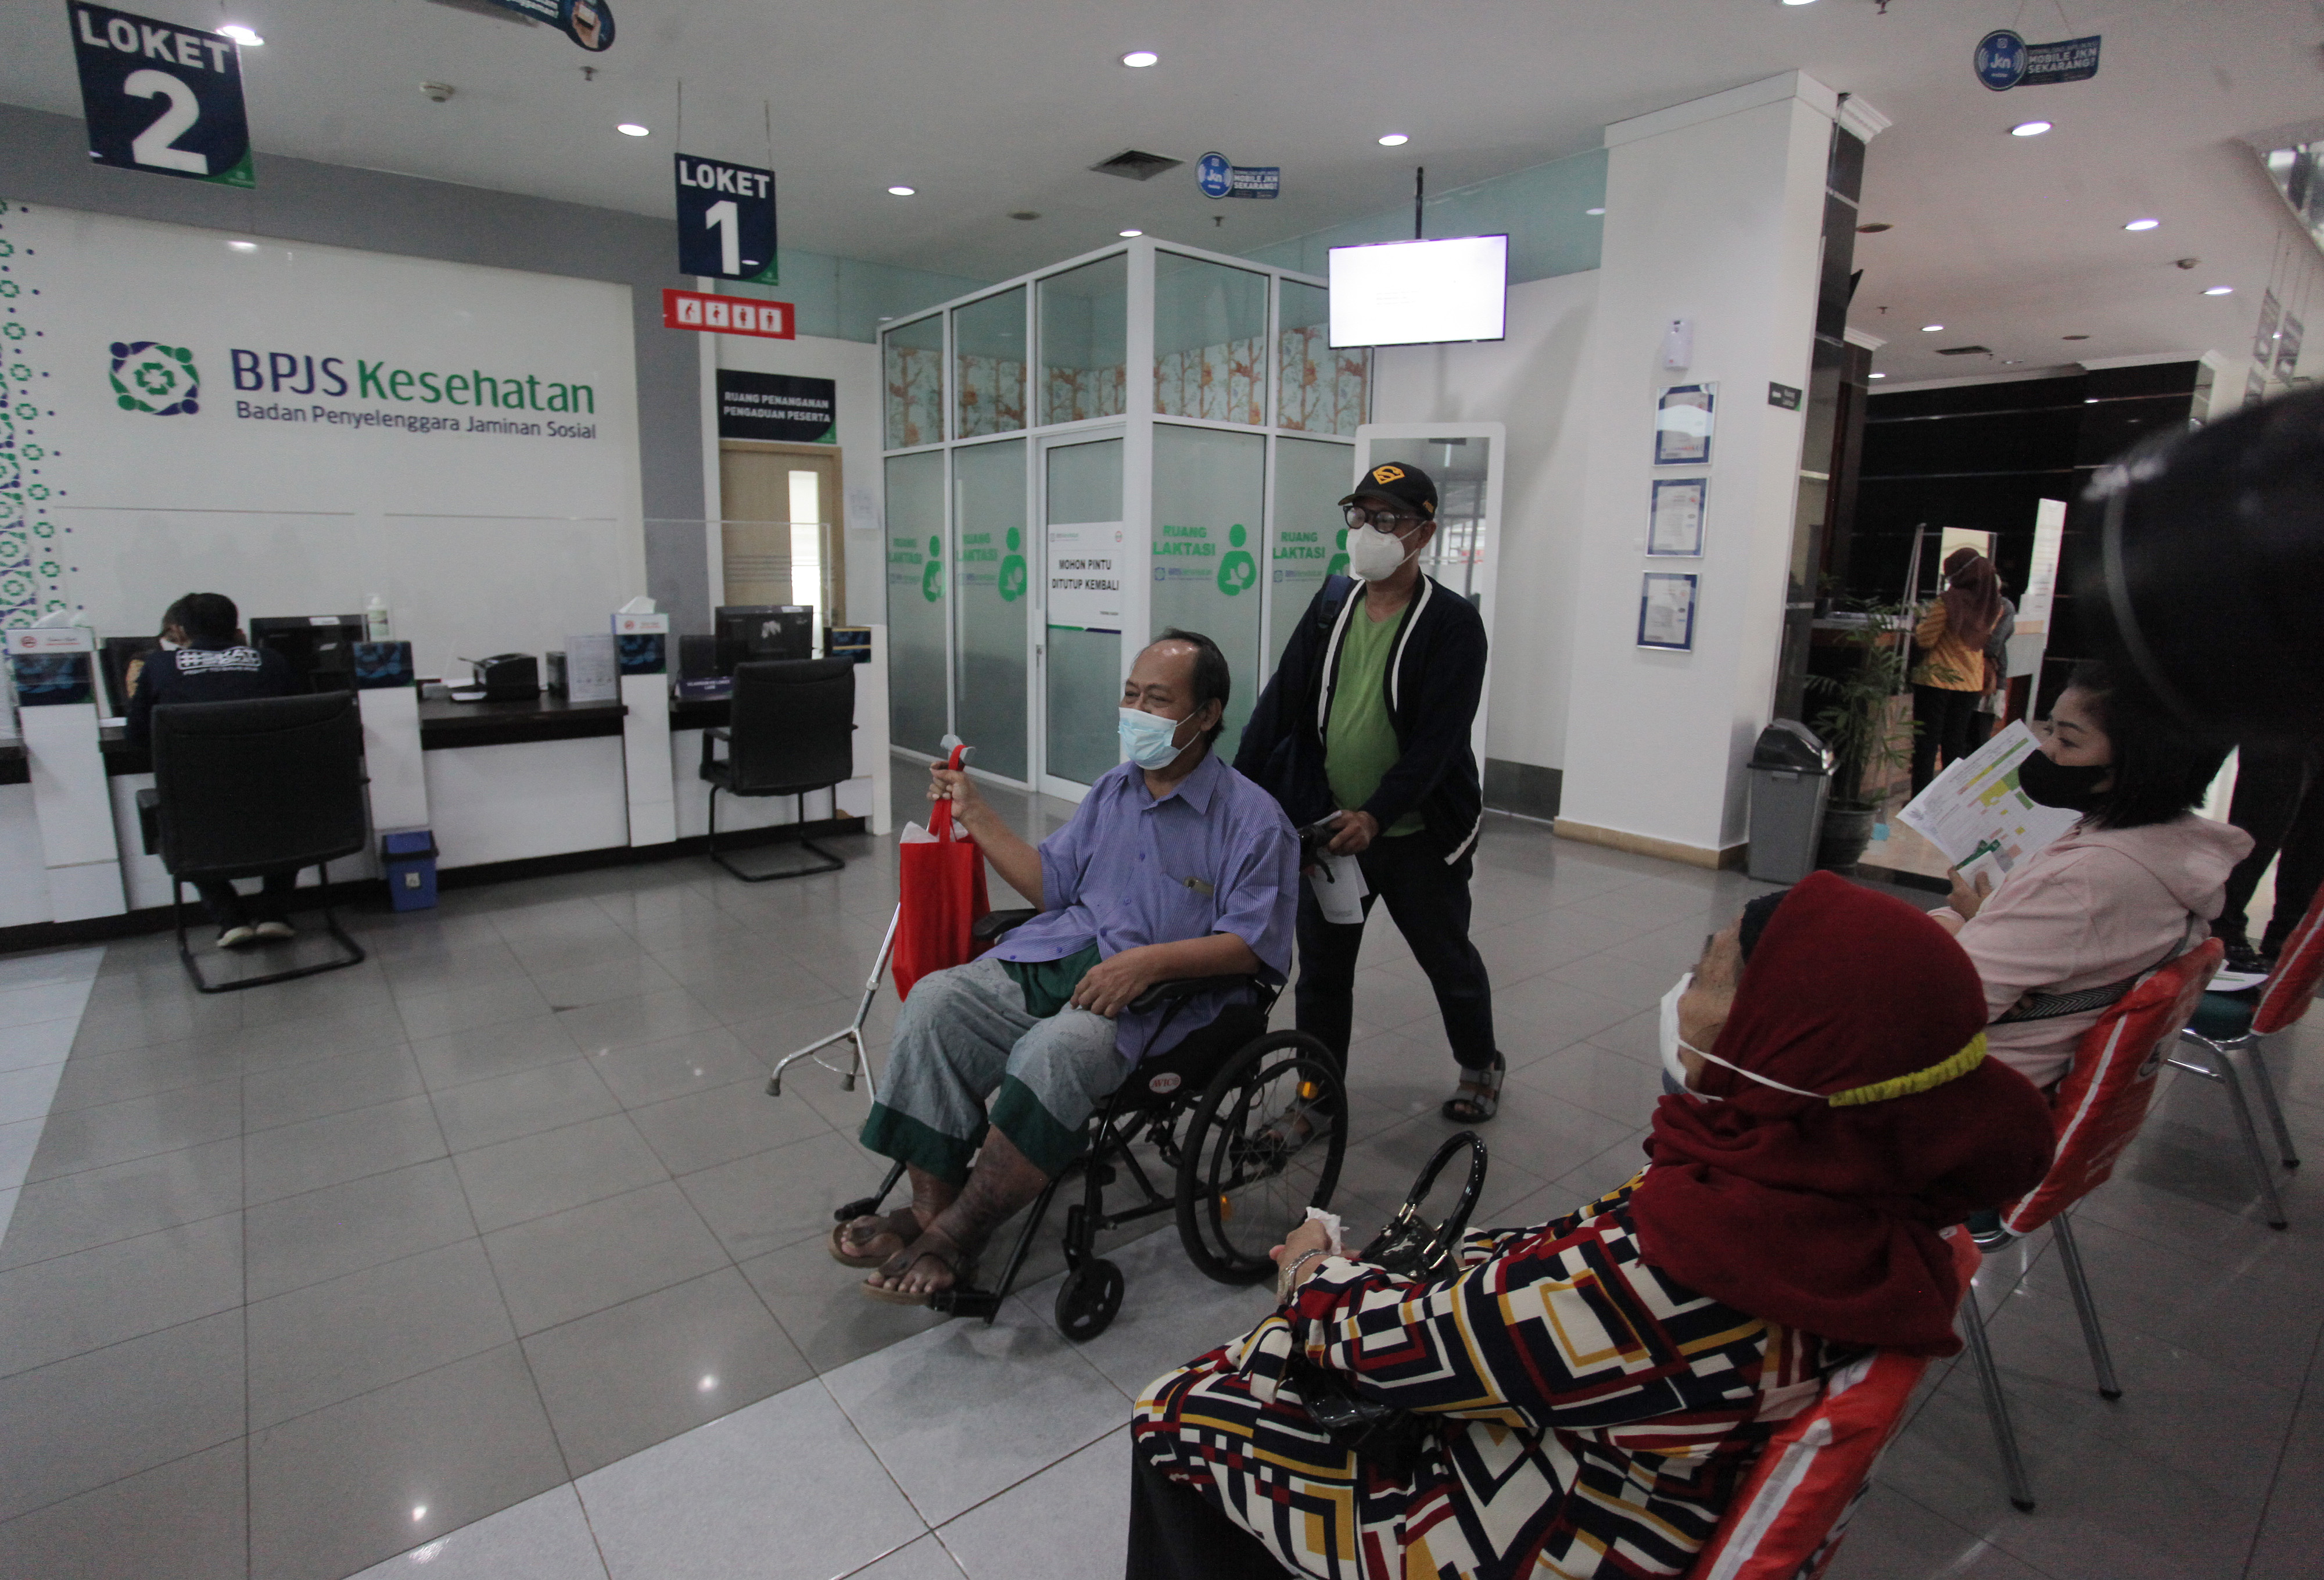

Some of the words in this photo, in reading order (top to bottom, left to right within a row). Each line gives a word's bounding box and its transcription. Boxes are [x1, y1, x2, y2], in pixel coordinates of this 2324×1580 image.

[78, 9, 229, 74] LOKET
[123, 69, 209, 175] 2
[679, 160, 770, 199] LOKET
[705, 200, 740, 275] 1
[231, 349, 348, 396] BPJS
[357, 359, 595, 414] Kesehatan
[725, 391, 760, 403] RUANG
[762, 394, 829, 409] PENANGANAN
[236, 400, 306, 422] Badan
[313, 405, 460, 433] Penyelenggara
[465, 416, 541, 436] Jaminan
[547, 421, 596, 439] Sosial
[723, 406, 786, 419] PENGADUAN
[787, 410, 831, 422] PESERTA
[1163, 525, 1207, 538] RUANG
[1281, 531, 1318, 542] RUANG
[1153, 542, 1215, 556] LAKTASI
[1272, 547, 1325, 559] LAKTASI
[1059, 559, 1085, 569] MOHON
[1088, 559, 1111, 570] PINTU
[1052, 579, 1082, 589] DITUTUP
[1085, 579, 1120, 590] KEMBALI
